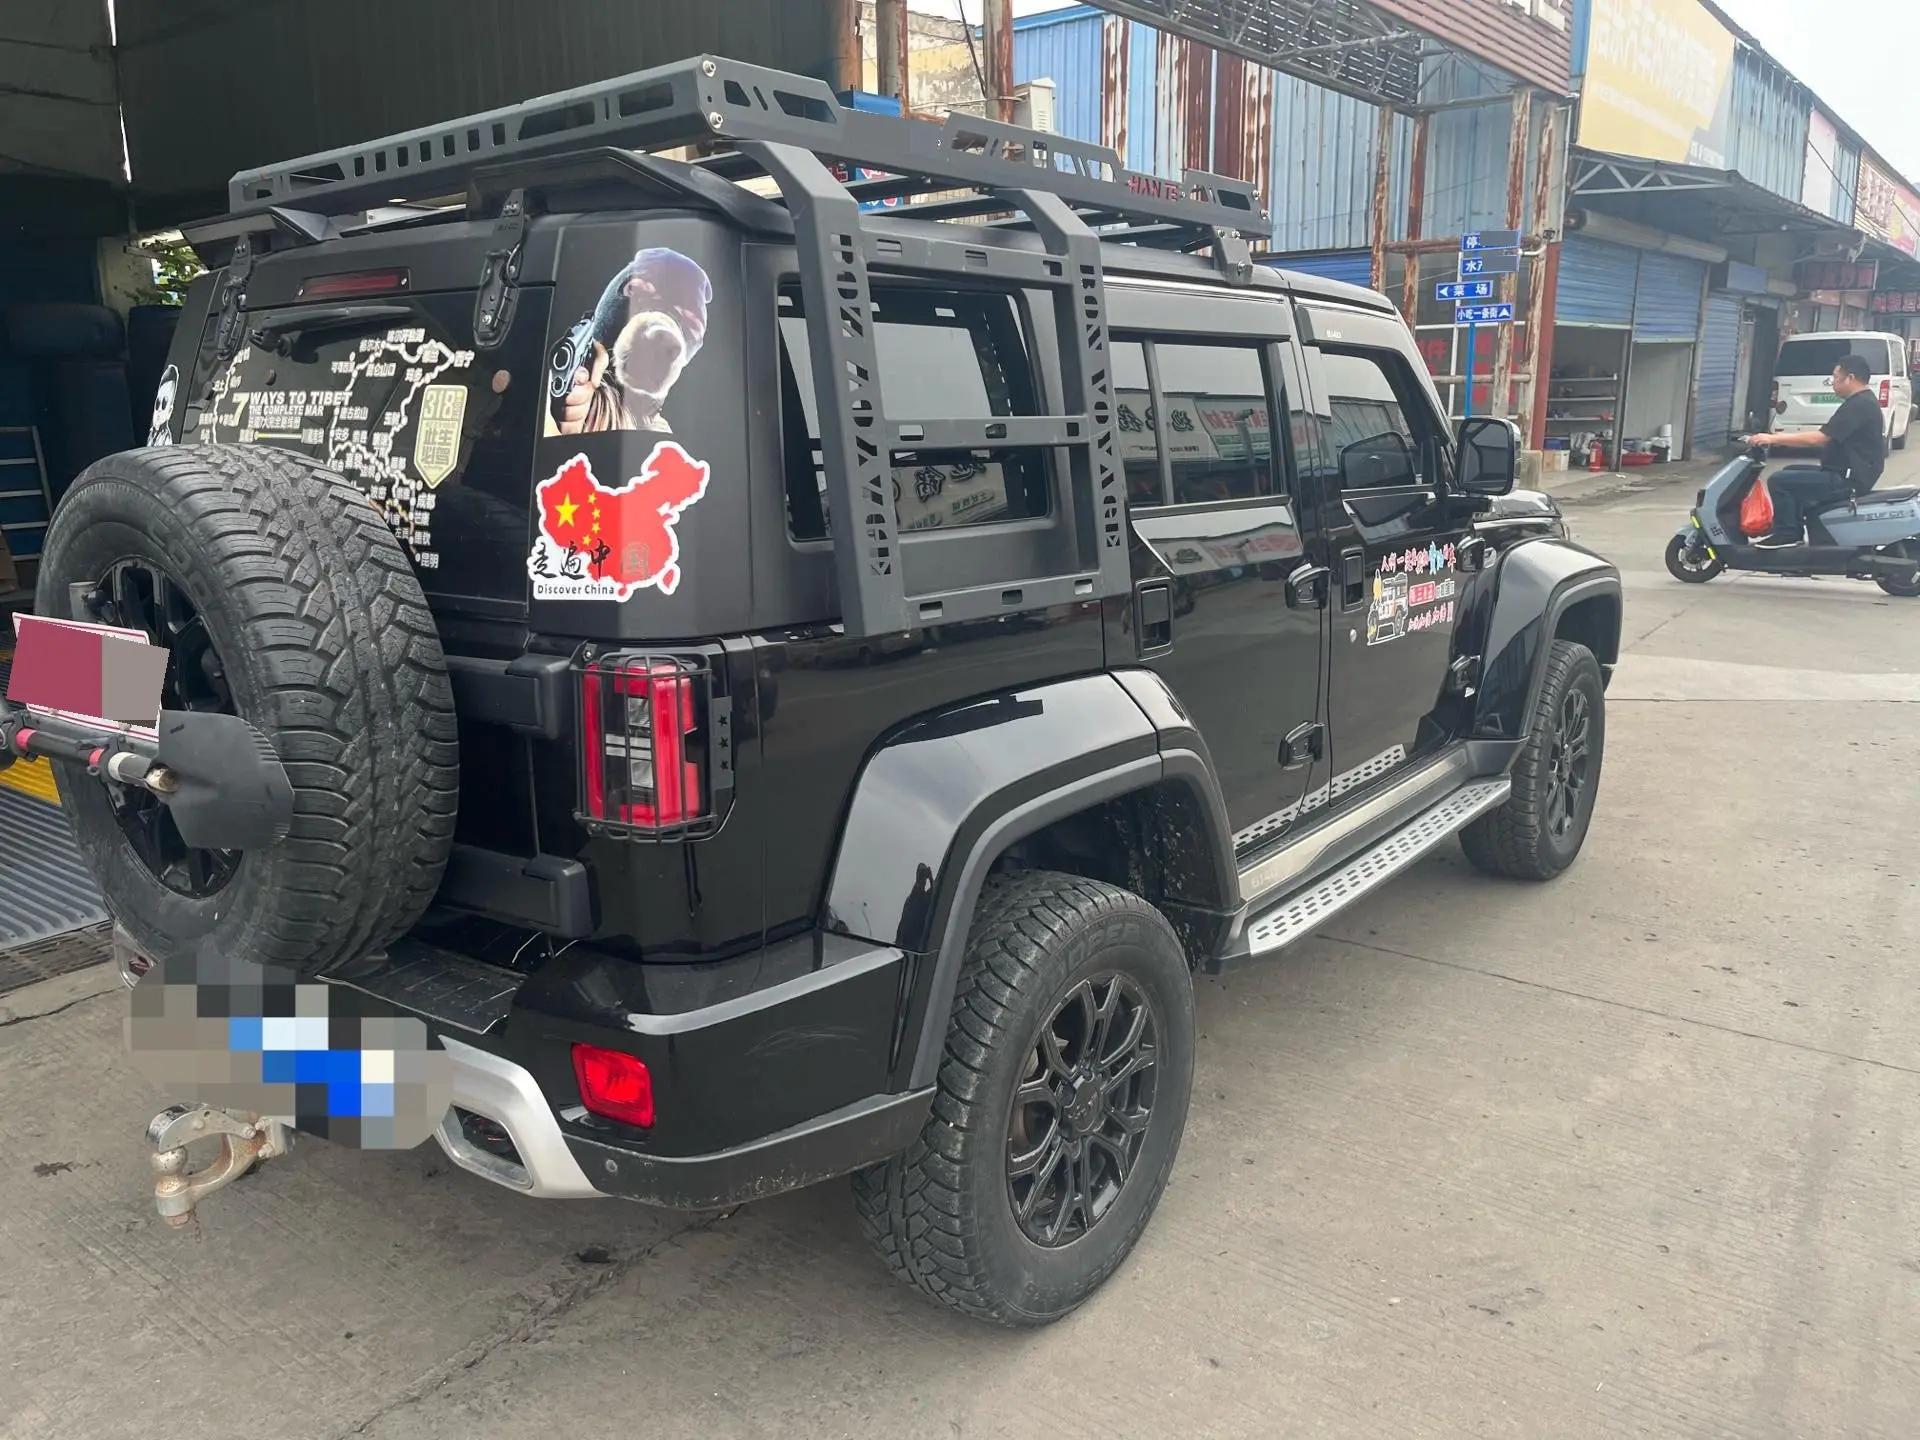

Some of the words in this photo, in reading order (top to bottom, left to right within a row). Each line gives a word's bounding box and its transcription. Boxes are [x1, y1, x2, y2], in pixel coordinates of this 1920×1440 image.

[1079, 264, 1103, 352] BON
[1457, 307, 1498, 320] 小吃一条街
[454, 350, 475, 368] 西宁
[231, 392, 250, 426] 7
[249, 392, 285, 405] WAYS
[288, 392, 306, 405] TO
[310, 391, 353, 406] TIBET
[249, 405, 263, 415] THE
[264, 405, 304, 415] COMPLETE
[423, 389, 456, 419] 318
[335, 428, 349, 441] 安多
[424, 428, 454, 446] 此生
[416, 492, 437, 510] 成都
[421, 552, 439, 569] 昆明
[537, 584, 582, 595] Discover
[584, 584, 615, 595] China
